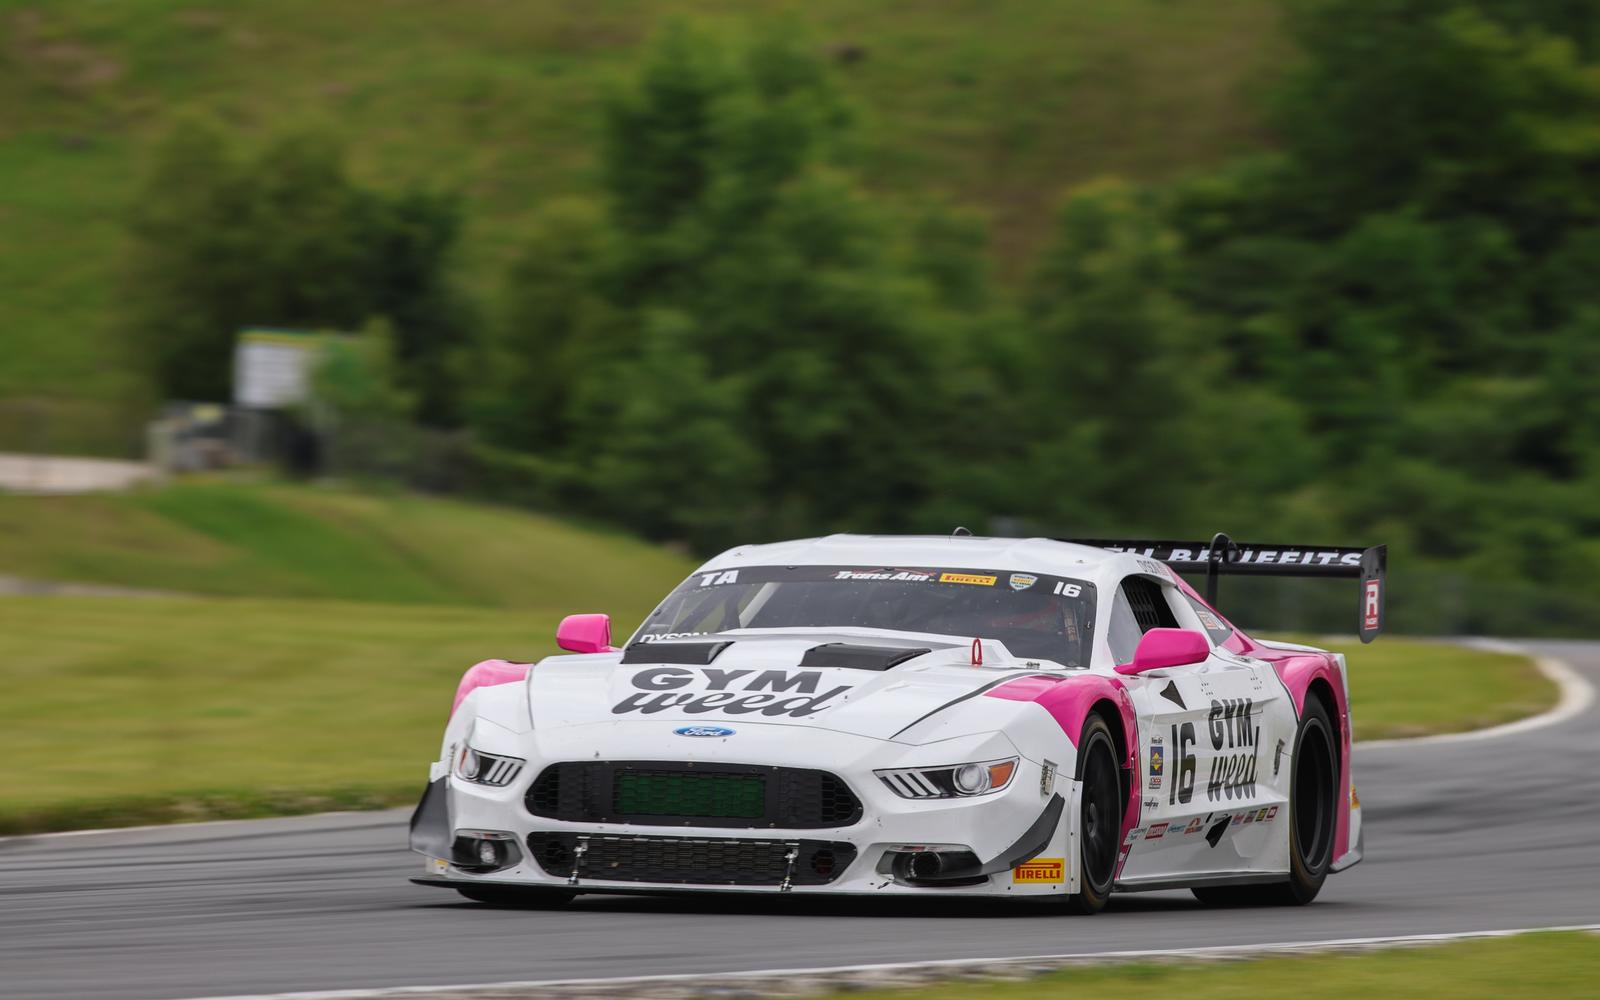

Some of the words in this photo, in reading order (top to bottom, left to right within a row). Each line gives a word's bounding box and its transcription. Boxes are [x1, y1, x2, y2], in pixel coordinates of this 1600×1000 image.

[701, 569, 740, 588] TA
[834, 570, 889, 581] Trans
[889, 571, 930, 582] Am
[1053, 581, 1083, 598] 16
[631, 667, 823, 694] GYM
[611, 685, 855, 718] weed
[683, 726, 725, 737] Ford
[1208, 698, 1253, 751] GYM
[1169, 721, 1197, 806] 16
[1207, 725, 1260, 803] weed
[1015, 862, 1062, 880] PIRELLI
